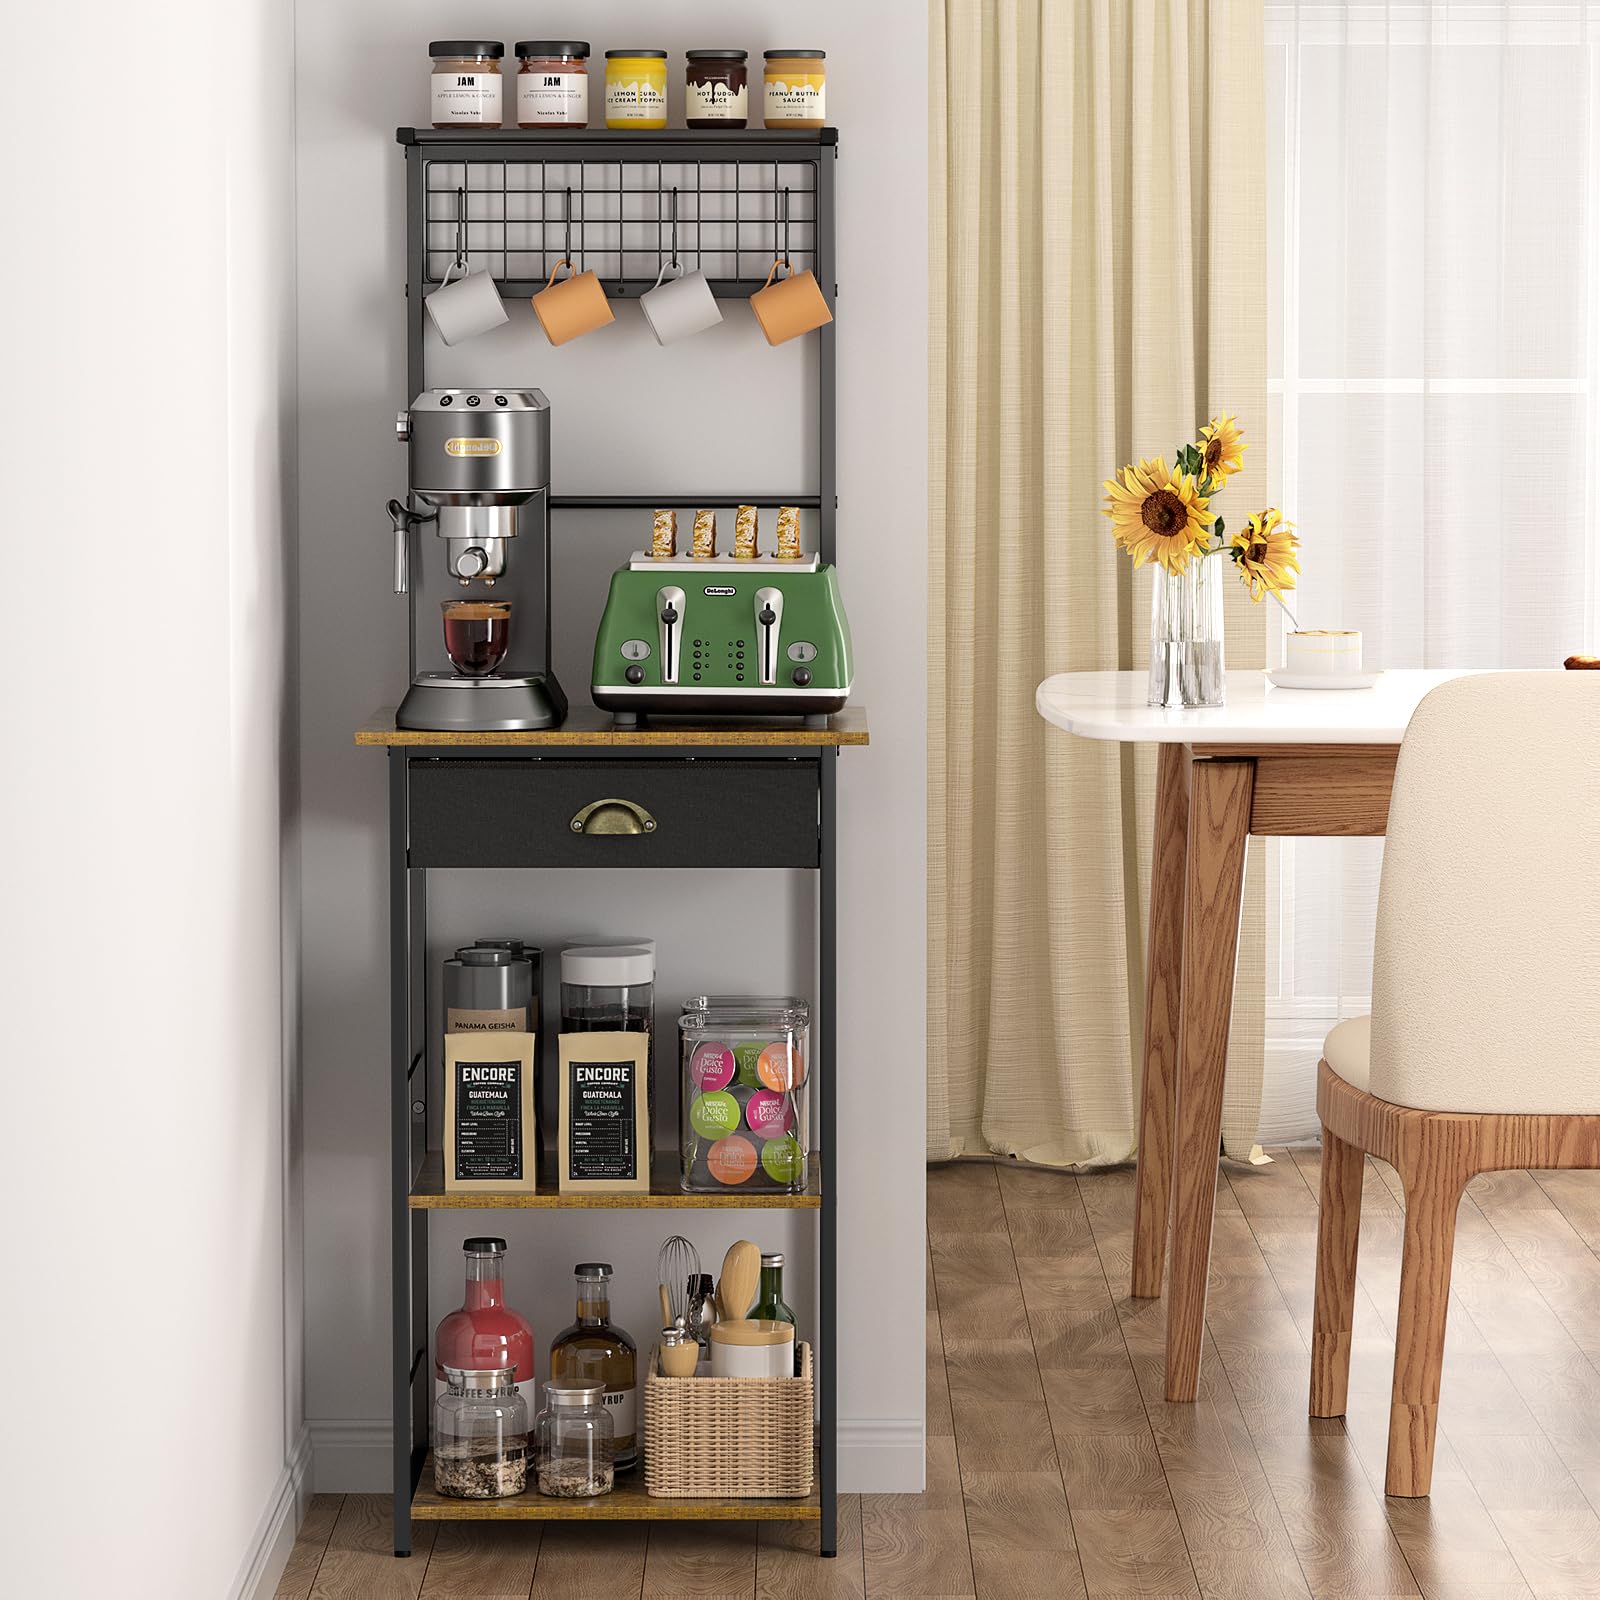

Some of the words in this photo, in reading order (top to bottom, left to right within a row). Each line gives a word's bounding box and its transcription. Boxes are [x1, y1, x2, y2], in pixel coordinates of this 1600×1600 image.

[457, 76, 475, 87] JAM
[543, 77, 561, 87] JAM
[455, 1022, 487, 1030] PANAMA
[488, 1022, 516, 1030] GEISHA
[700, 1057, 724, 1068] Dolce
[462, 1067, 516, 1082] ENCORE
[576, 1067, 630, 1082] ENCORE
[468, 1091, 508, 1099] GUATEMALA
[582, 1091, 622, 1099] GUATEMALA
[702, 1106, 729, 1115] Dolce
[758, 1106, 783, 1115] Dolce
[702, 1113, 728, 1122] Gusto
[759, 1113, 784, 1122] Gusto
[448, 1386, 483, 1399] COFFEE
[485, 1386, 520, 1399] SYRUP
[601, 1394, 625, 1405] YRUP
